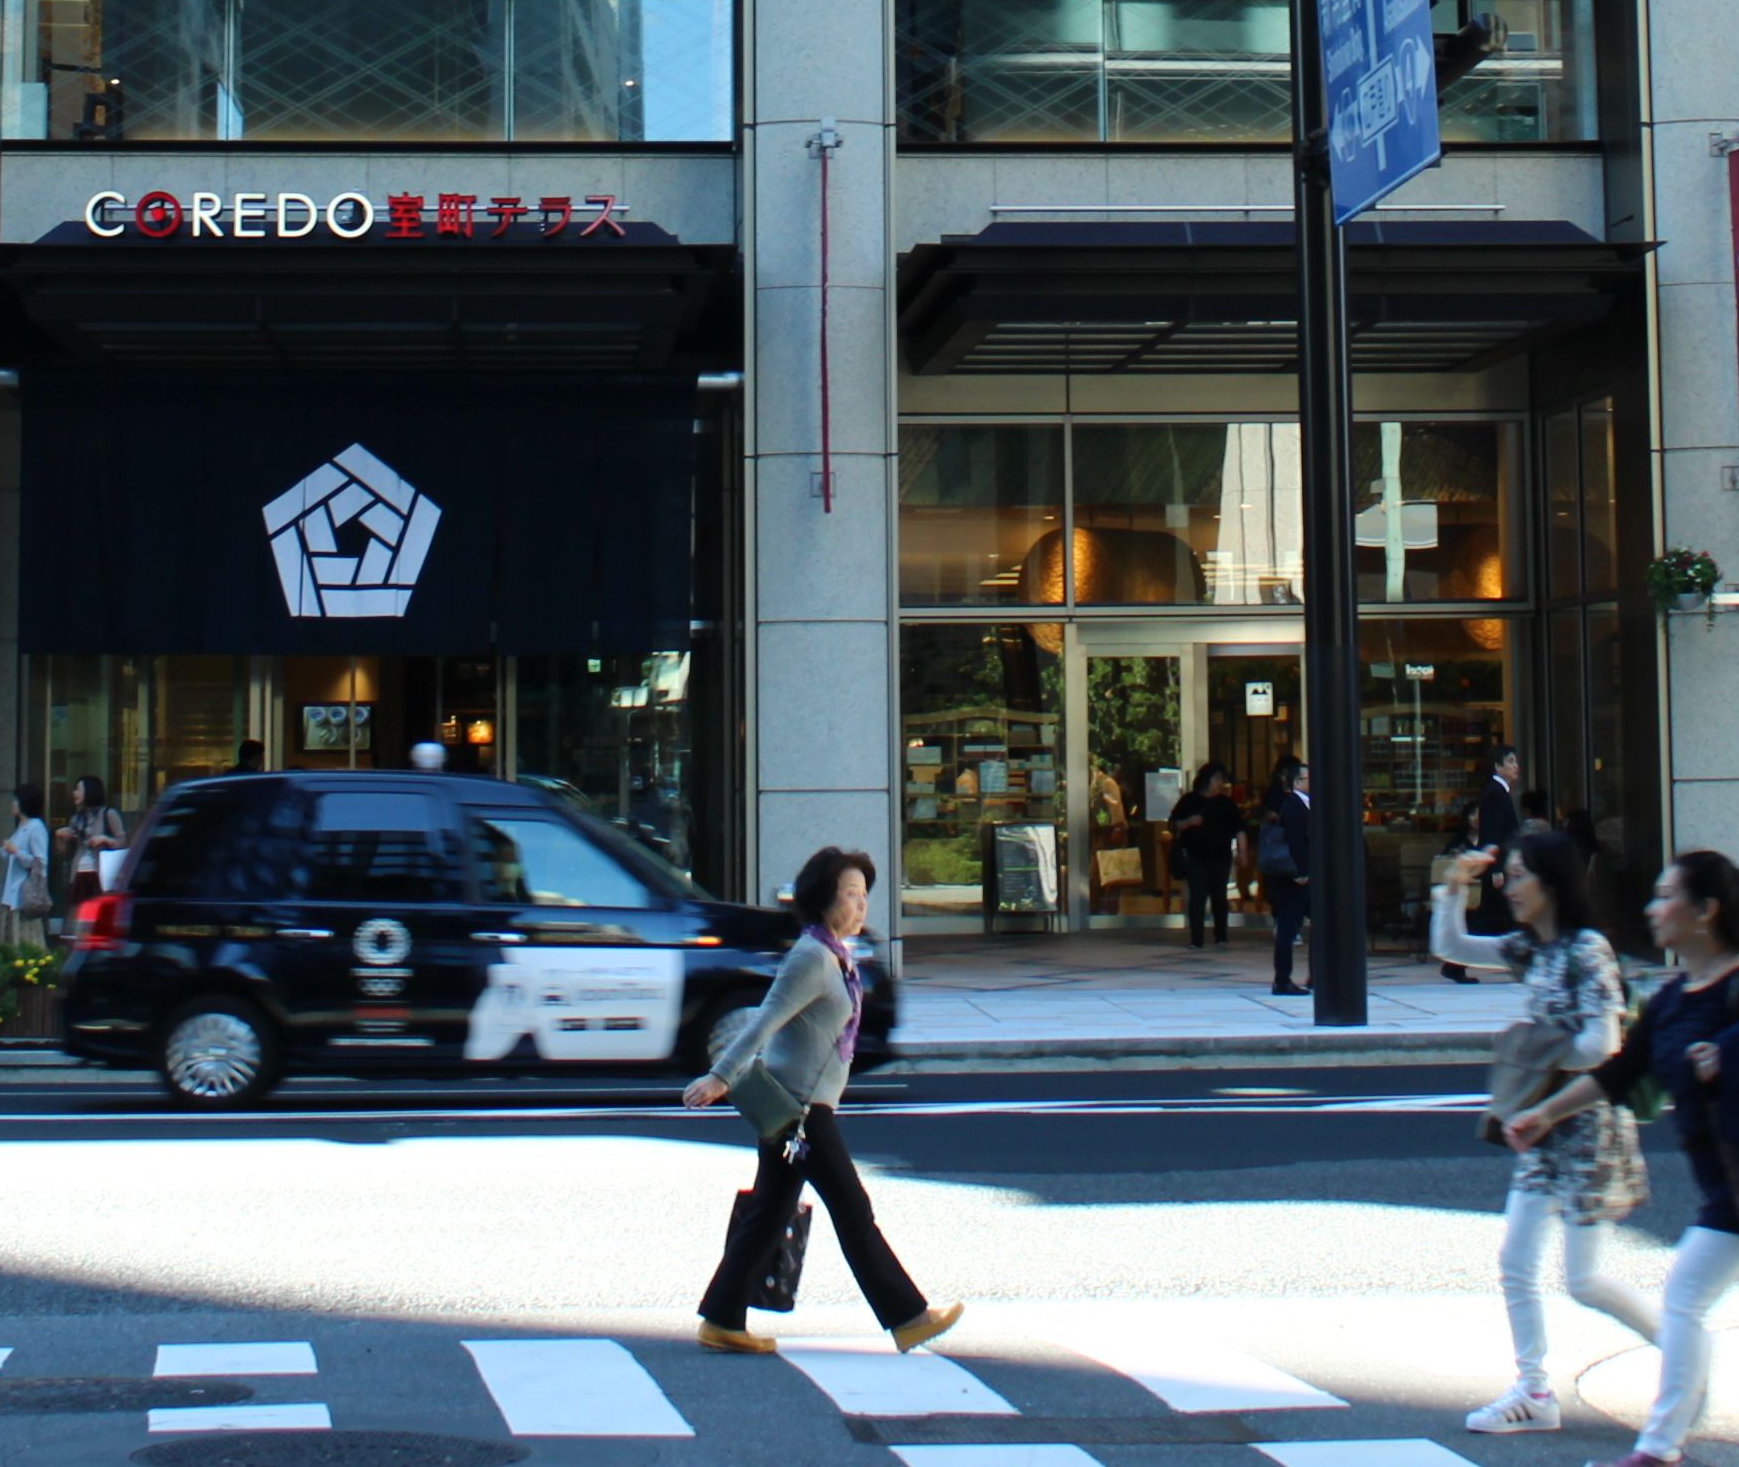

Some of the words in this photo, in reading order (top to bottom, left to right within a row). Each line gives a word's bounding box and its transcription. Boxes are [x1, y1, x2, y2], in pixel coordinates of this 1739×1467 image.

[85, 190, 375, 239] COREDO
[386, 190, 627, 241] 室町テラス
